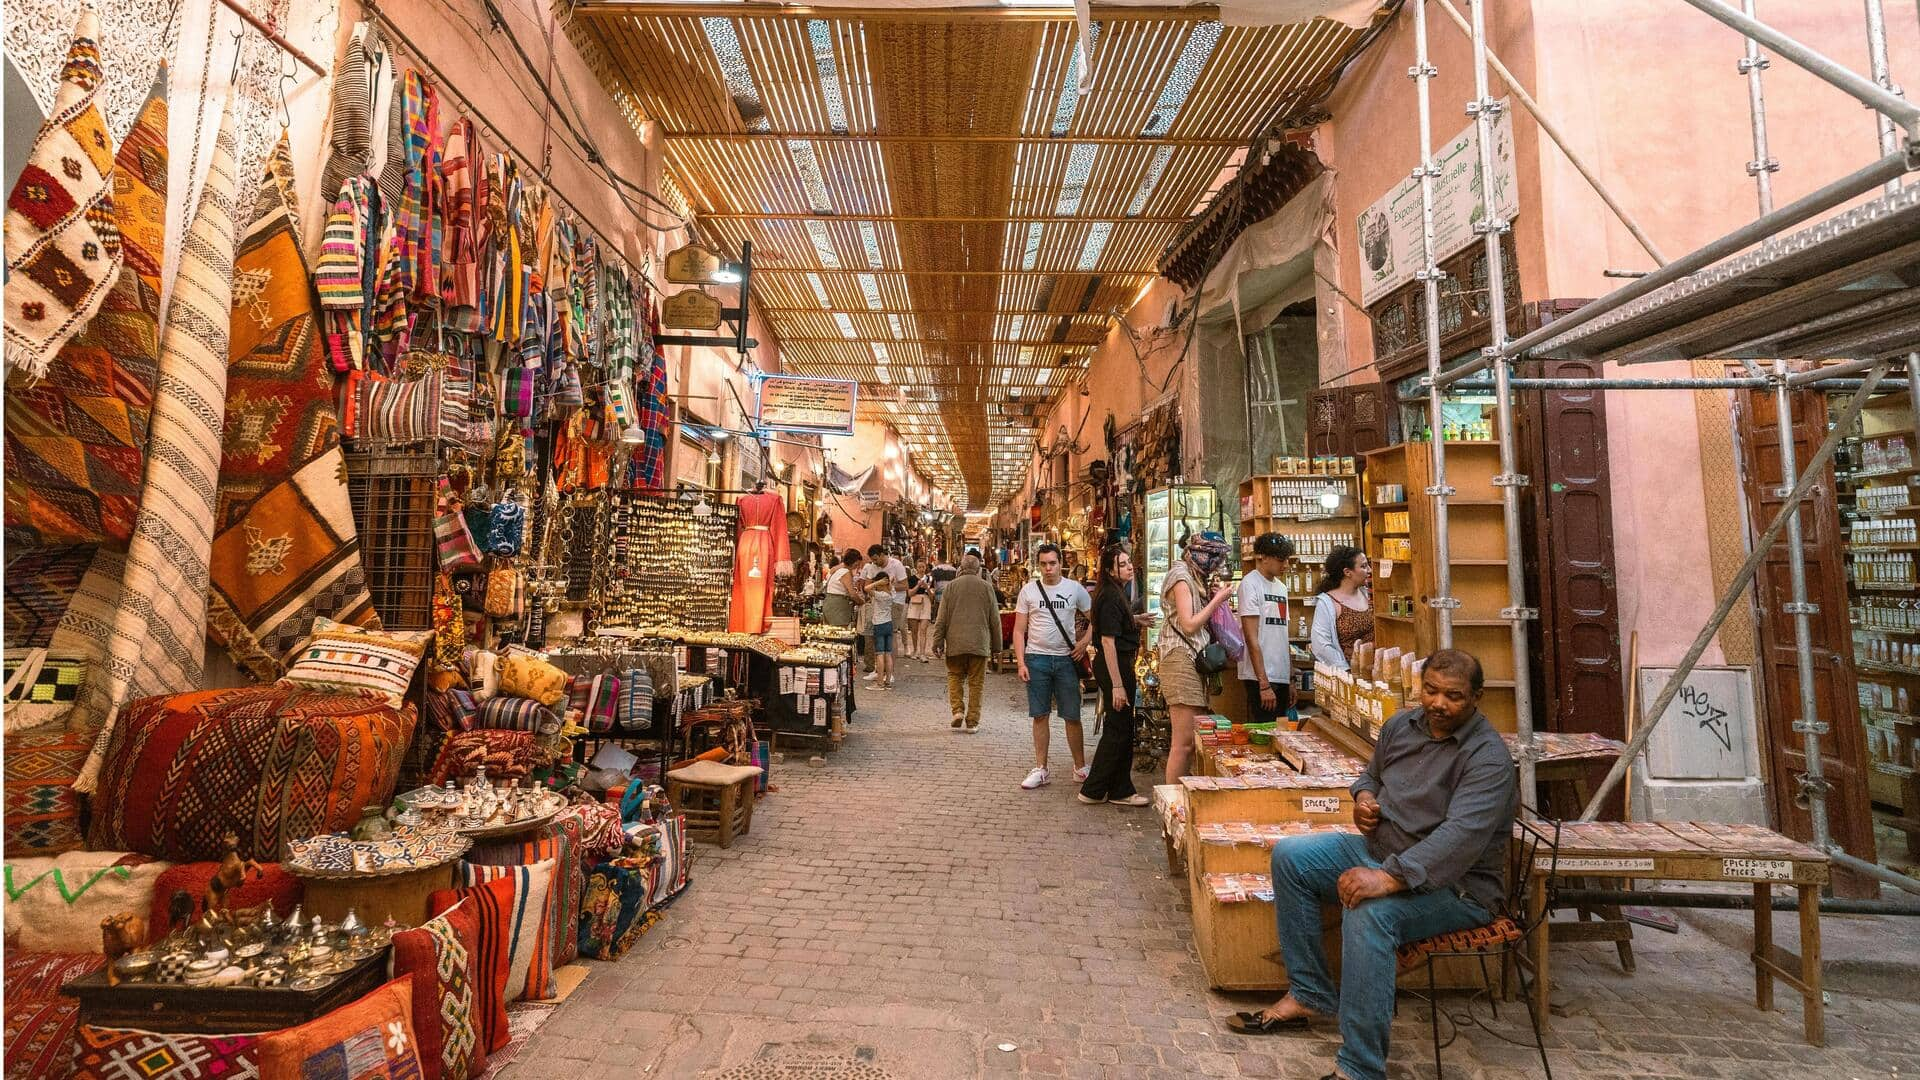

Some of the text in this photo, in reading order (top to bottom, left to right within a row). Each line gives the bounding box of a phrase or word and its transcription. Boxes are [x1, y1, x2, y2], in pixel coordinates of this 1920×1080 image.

[1394, 195, 1424, 223] Expositio
[1431, 161, 1468, 196] ndustrielle
[1305, 799, 1326, 807] SPICES
[1723, 867, 1756, 877] SPICES
[1764, 870, 1775, 879] 30
